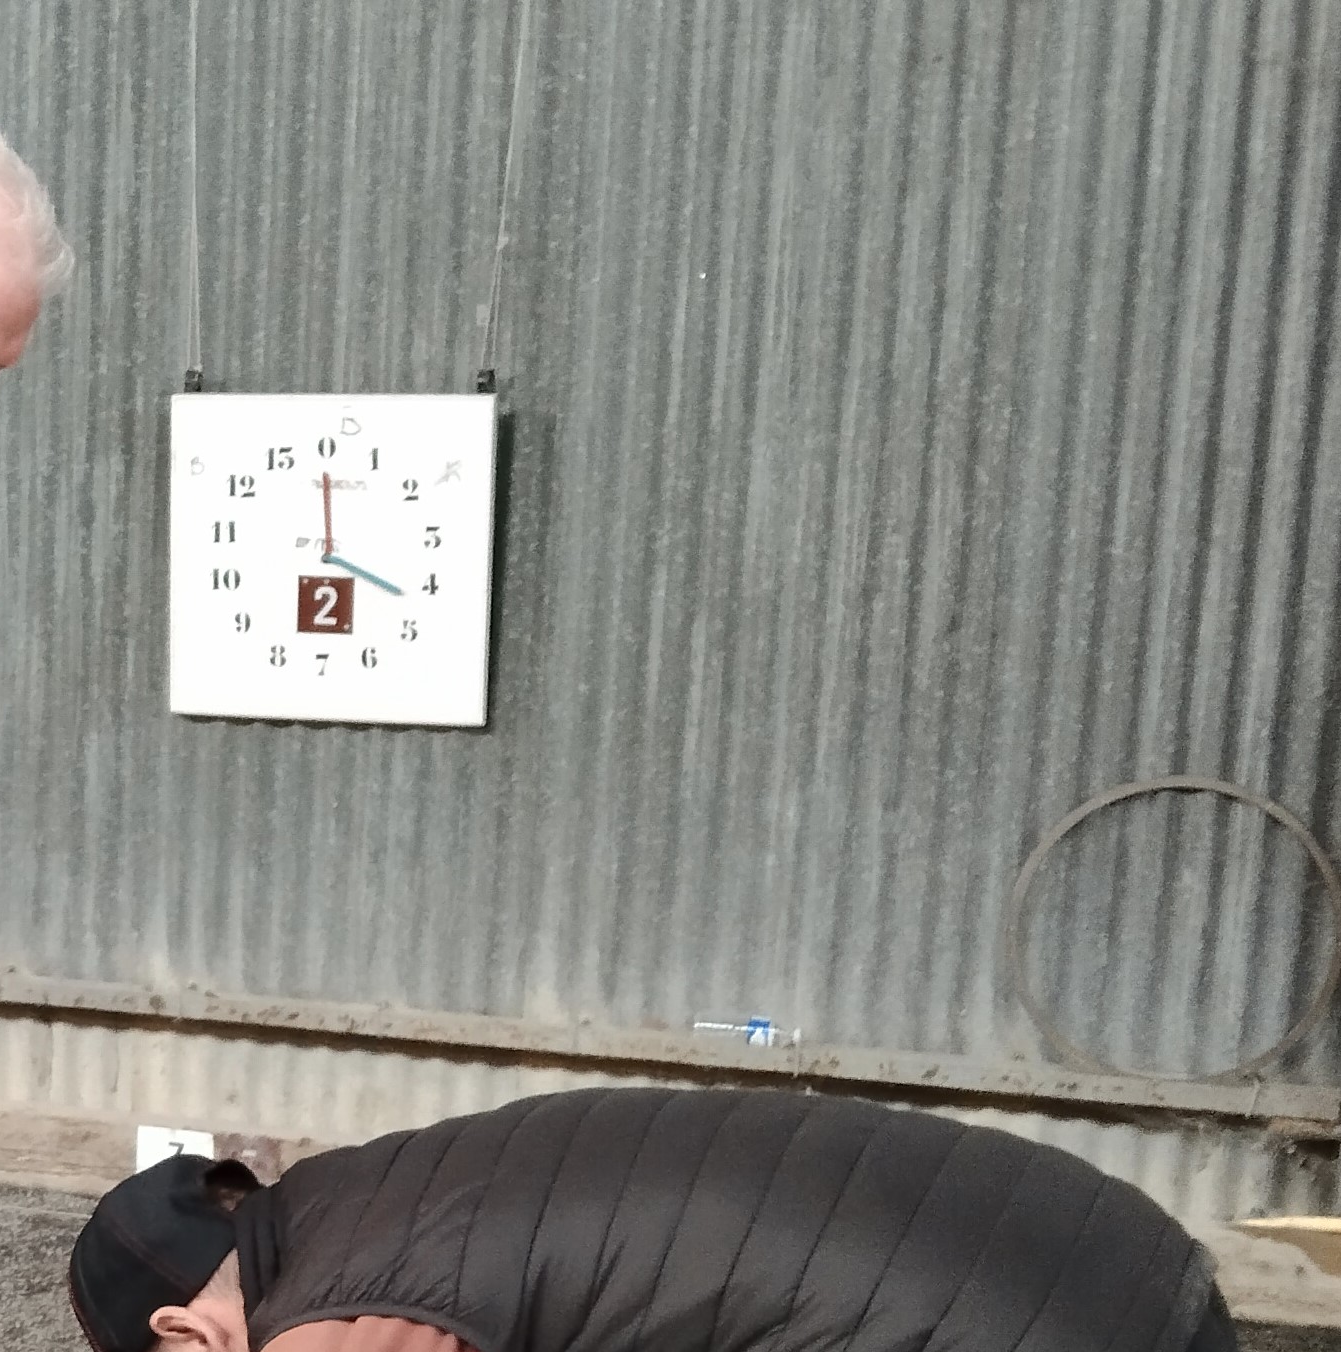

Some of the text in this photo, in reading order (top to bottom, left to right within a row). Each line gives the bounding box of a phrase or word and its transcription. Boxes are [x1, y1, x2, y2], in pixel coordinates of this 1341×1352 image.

[317, 436, 337, 459] 0
[368, 447, 380, 472] 1
[226, 474, 257, 499] 12
[402, 478, 420, 502] 2
[211, 520, 237, 544] 11
[210, 567, 242, 592] 10
[421, 572, 440, 597] 4
[313, 585, 339, 626] 2
[234, 611, 252, 634] 9
[400, 619, 419, 643] 5
[269, 644, 287, 668] 8
[315, 652, 330, 677] 7
[360, 646, 379, 670] 6
